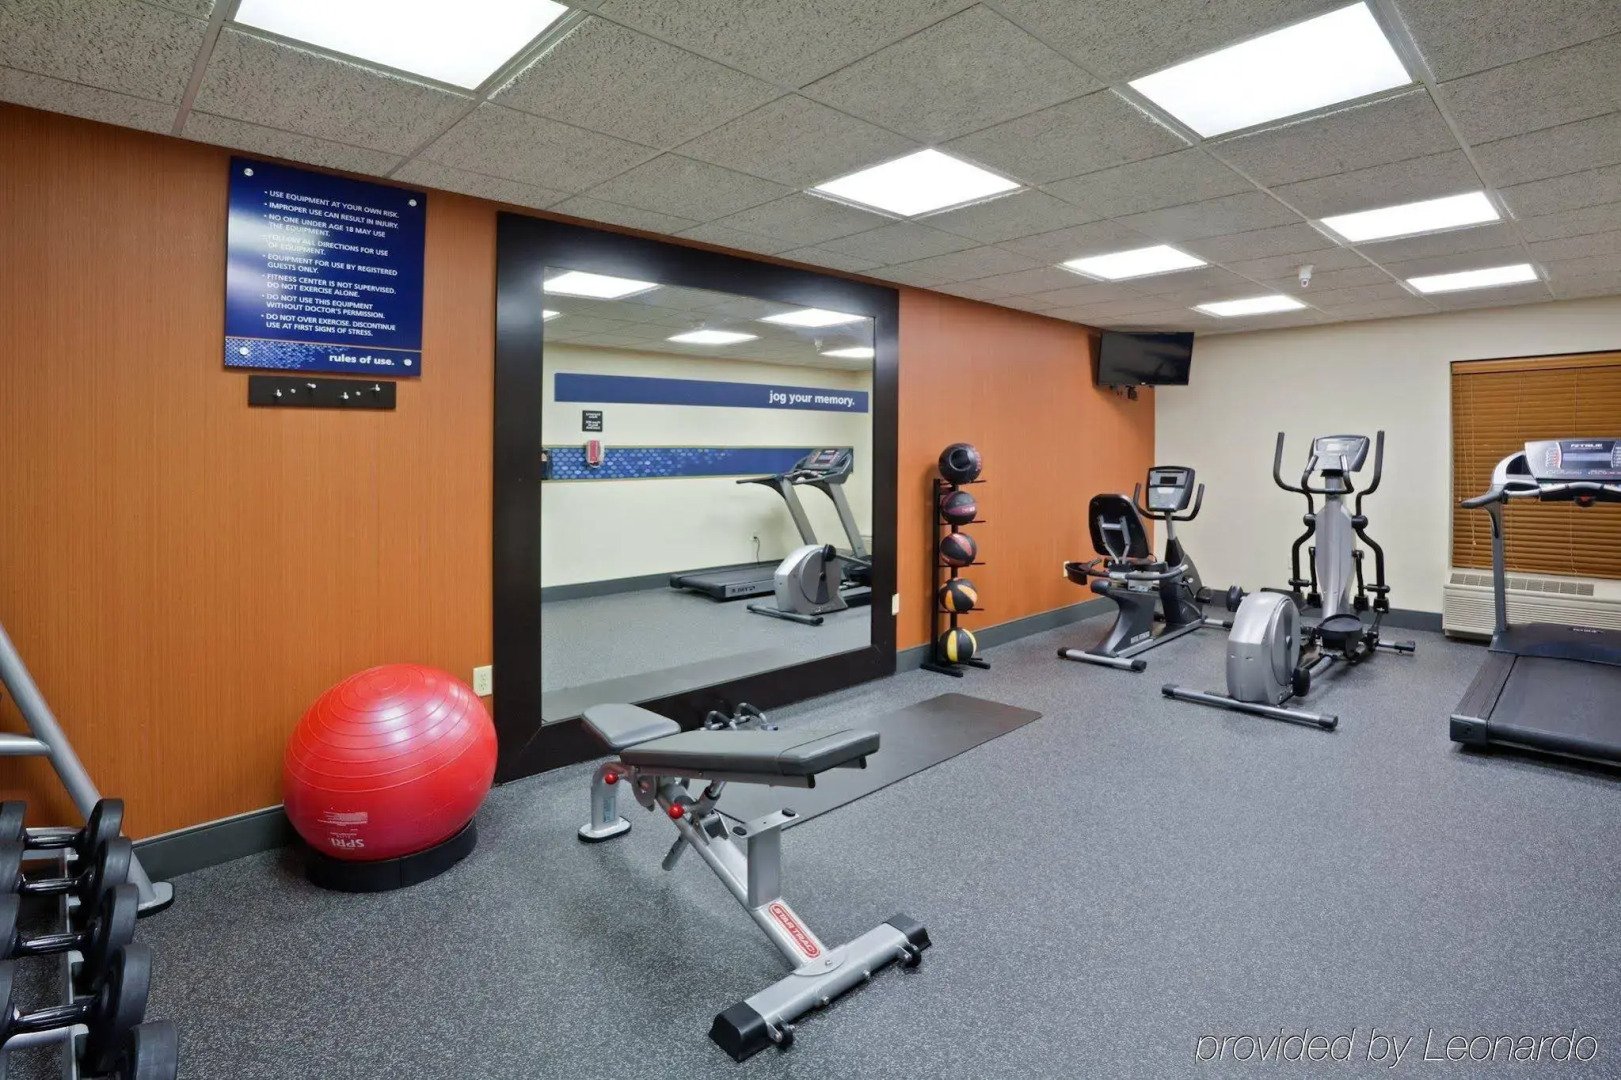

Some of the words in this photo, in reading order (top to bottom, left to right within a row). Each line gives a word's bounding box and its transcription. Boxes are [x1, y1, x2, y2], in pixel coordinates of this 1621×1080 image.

[270, 190, 284, 198] USE
[286, 193, 330, 206] EQUIPMENT
[342, 203, 362, 212] YOUR
[364, 207, 381, 215] OWN
[383, 210, 399, 218] RISK.
[270, 202, 307, 214] IMPROPER
[341, 214, 365, 223] RESULT
[375, 219, 399, 229] INJURY.
[269, 222, 282, 230] THE
[286, 224, 330, 236] EQUIPMENT.
[302, 218, 327, 228] UNDER
[328, 223, 343, 231] AGE
[373, 230, 386, 238] USE
[284, 244, 326, 255] EQUIPMENT.
[302, 238, 316, 246] ALL
[318, 241, 359, 252] DIRECTIONS
[268, 254, 312, 265] EQUIPMENT
[358, 266, 398, 276] REGISTERED
[268, 262, 296, 271] GUESTS
[298, 266, 319, 274] ONLY.
[267, 274, 297, 282] FITNESS
[299, 277, 327, 286] CENTER
[354, 284, 396, 294] SUPERVISED.
[300, 286, 332, 295] EXERCISE
[334, 289, 360, 297] ALONE.
[266, 302, 303, 310] WITHOUT
[305, 305, 341, 314] DOCTOR'S
[343, 309, 385, 318] PERMISSION.
[315, 298, 330, 306] THIS
[332, 300, 373, 309] EQUIPMENT
[298, 316, 317, 324] OVER
[319, 318, 351, 327] EXERCISE.
[352, 321, 396, 331] DISCONTINUE
[329, 354, 356, 363] rules
[359, 356, 371, 364] of
[374, 358, 394, 366] use.
[769, 390, 786, 404] jog
[789, 394, 812, 404] your
[814, 395, 855, 407] memory.
[331, 838, 364, 848] SPRI
[774, 907, 795, 930] STAR
[792, 928, 816, 953] TRAC
